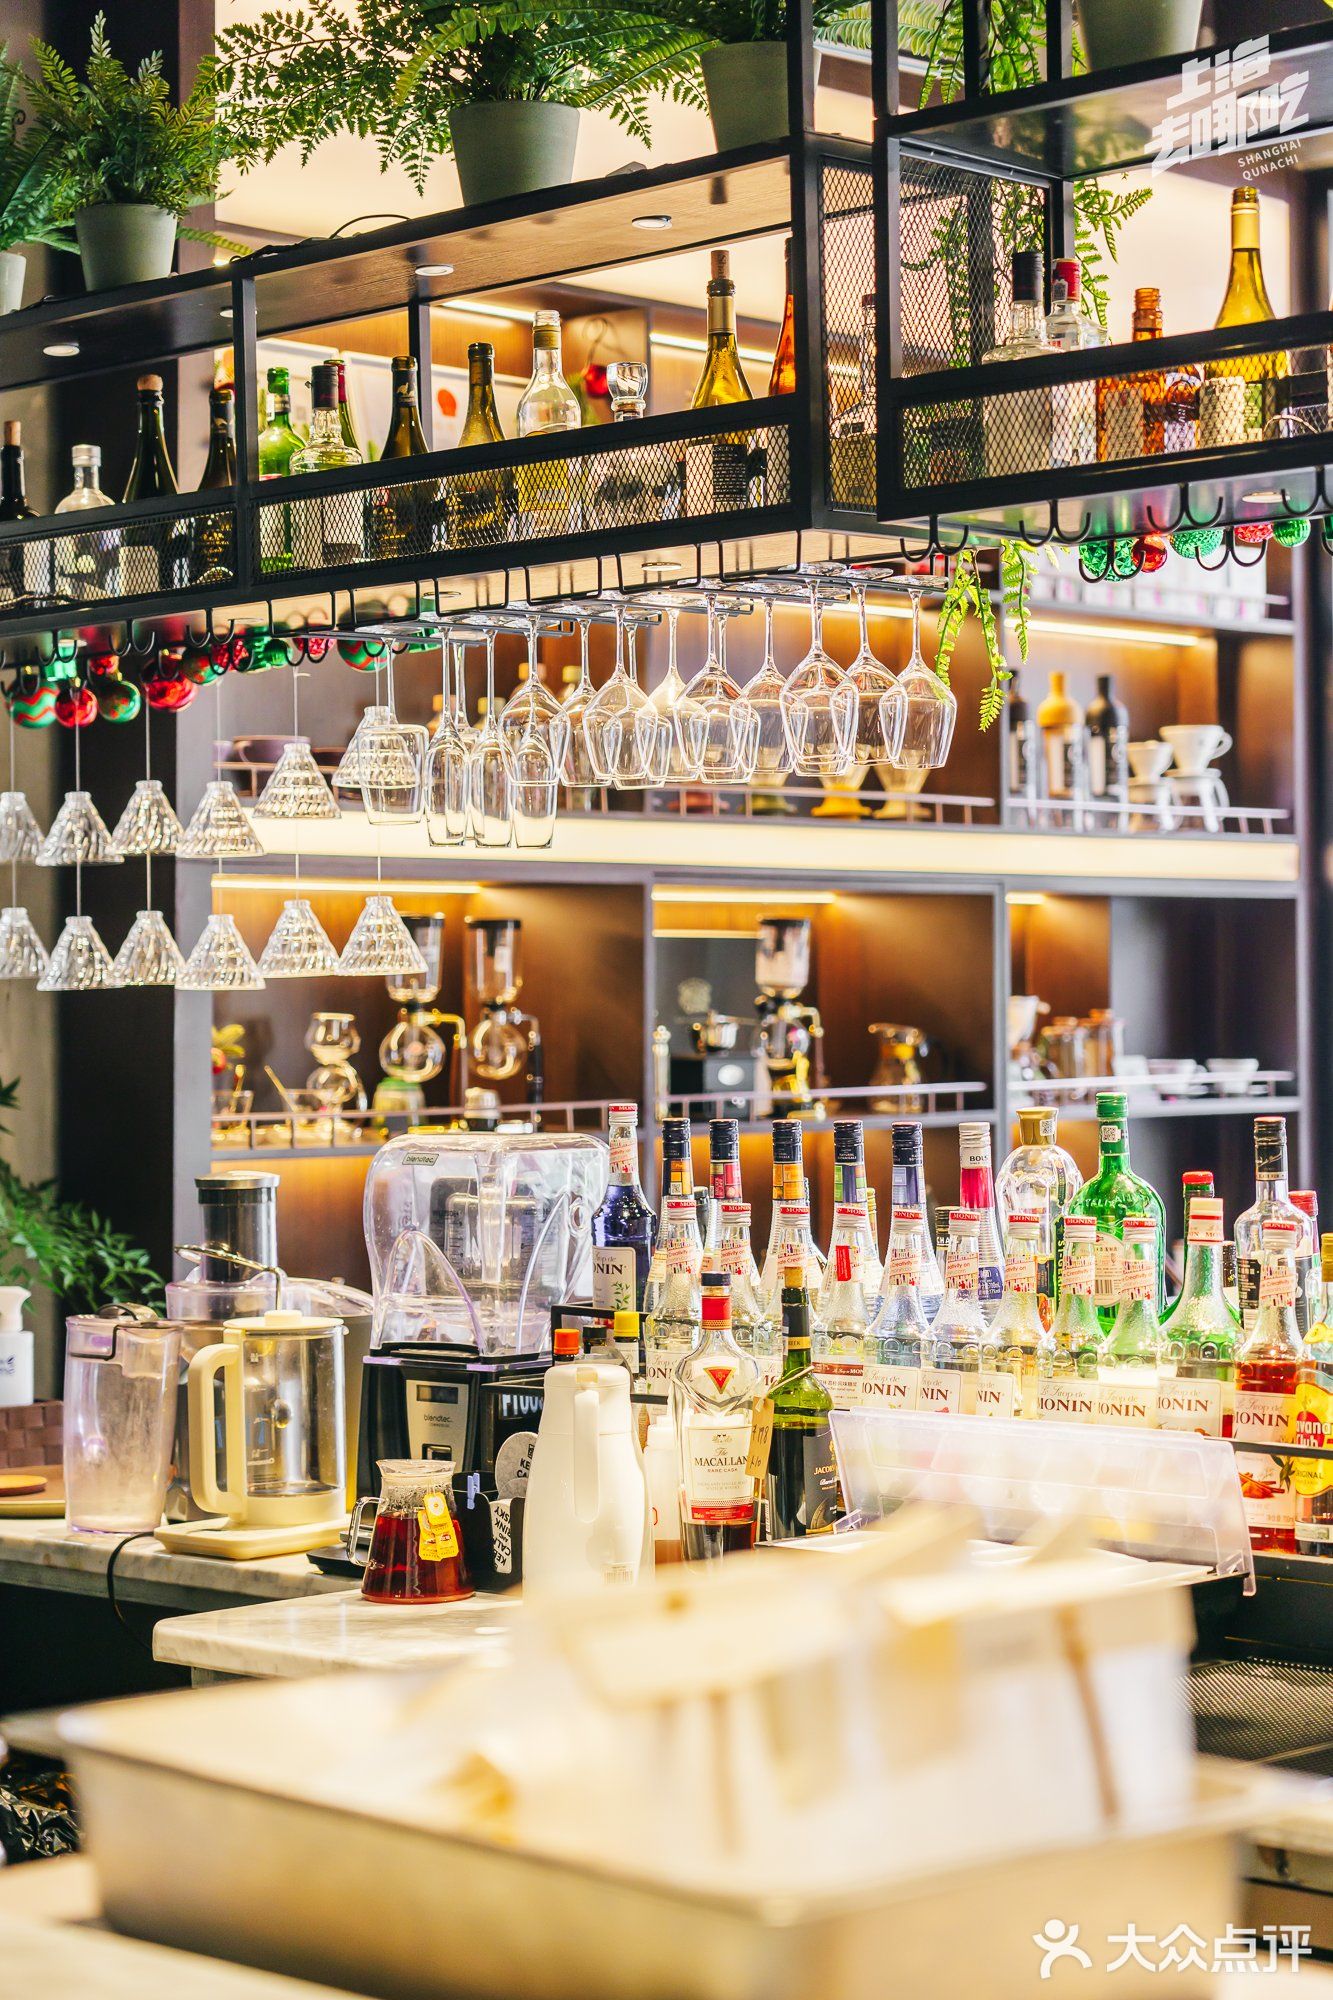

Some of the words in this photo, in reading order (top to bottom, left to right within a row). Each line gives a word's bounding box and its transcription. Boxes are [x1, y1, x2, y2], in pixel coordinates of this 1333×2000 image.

[862, 1382, 906, 1397] ONIN
[1098, 1402, 1146, 1417] ONIN
[423, 1414, 453, 1423] blendtec
[1235, 1411, 1290, 1427] ONIN
[694, 1456, 748, 1467] MACALLAN
